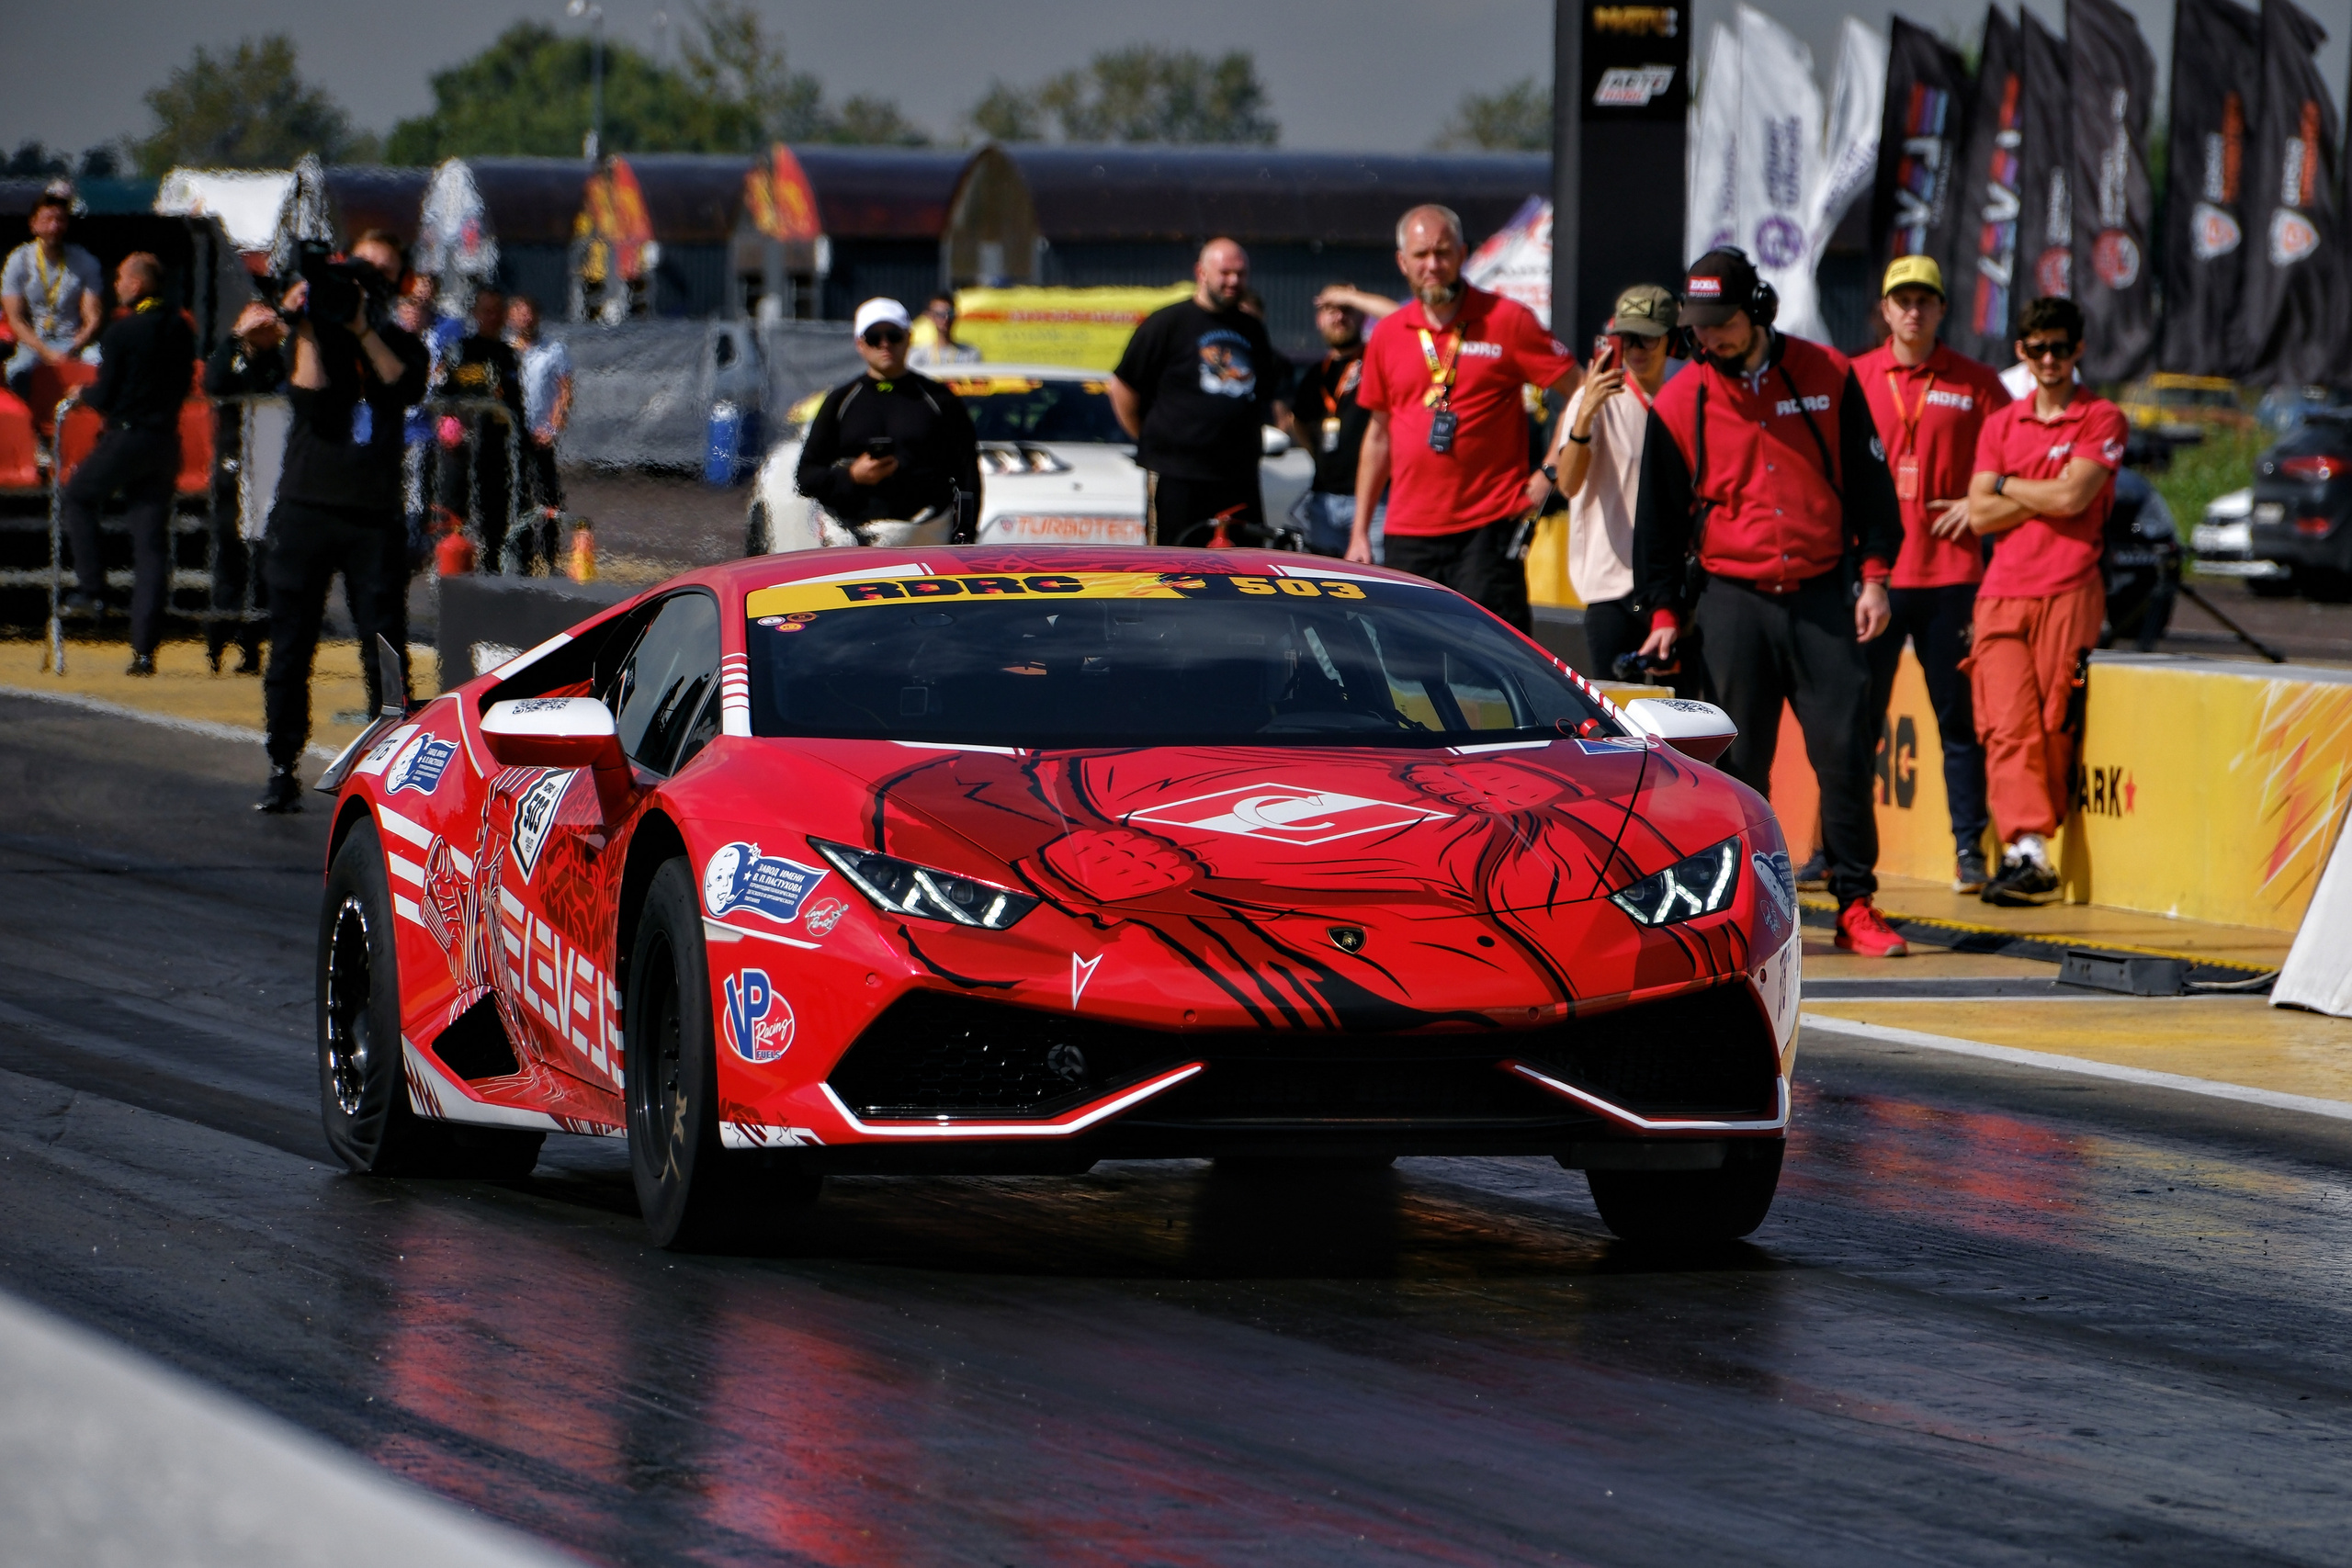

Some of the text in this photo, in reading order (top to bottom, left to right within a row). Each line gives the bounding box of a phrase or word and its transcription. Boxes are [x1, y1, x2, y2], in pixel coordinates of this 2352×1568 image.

[835, 576, 1085, 602] RDRC
[1230, 577, 1367, 599] 503
[524, 793, 550, 834] 503
[757, 863, 805, 883] ЗАВОД ИМЕНИ
[724, 968, 772, 1062] VP
[755, 1016, 793, 1049] Racing
[756, 1050, 781, 1059] FUELS
